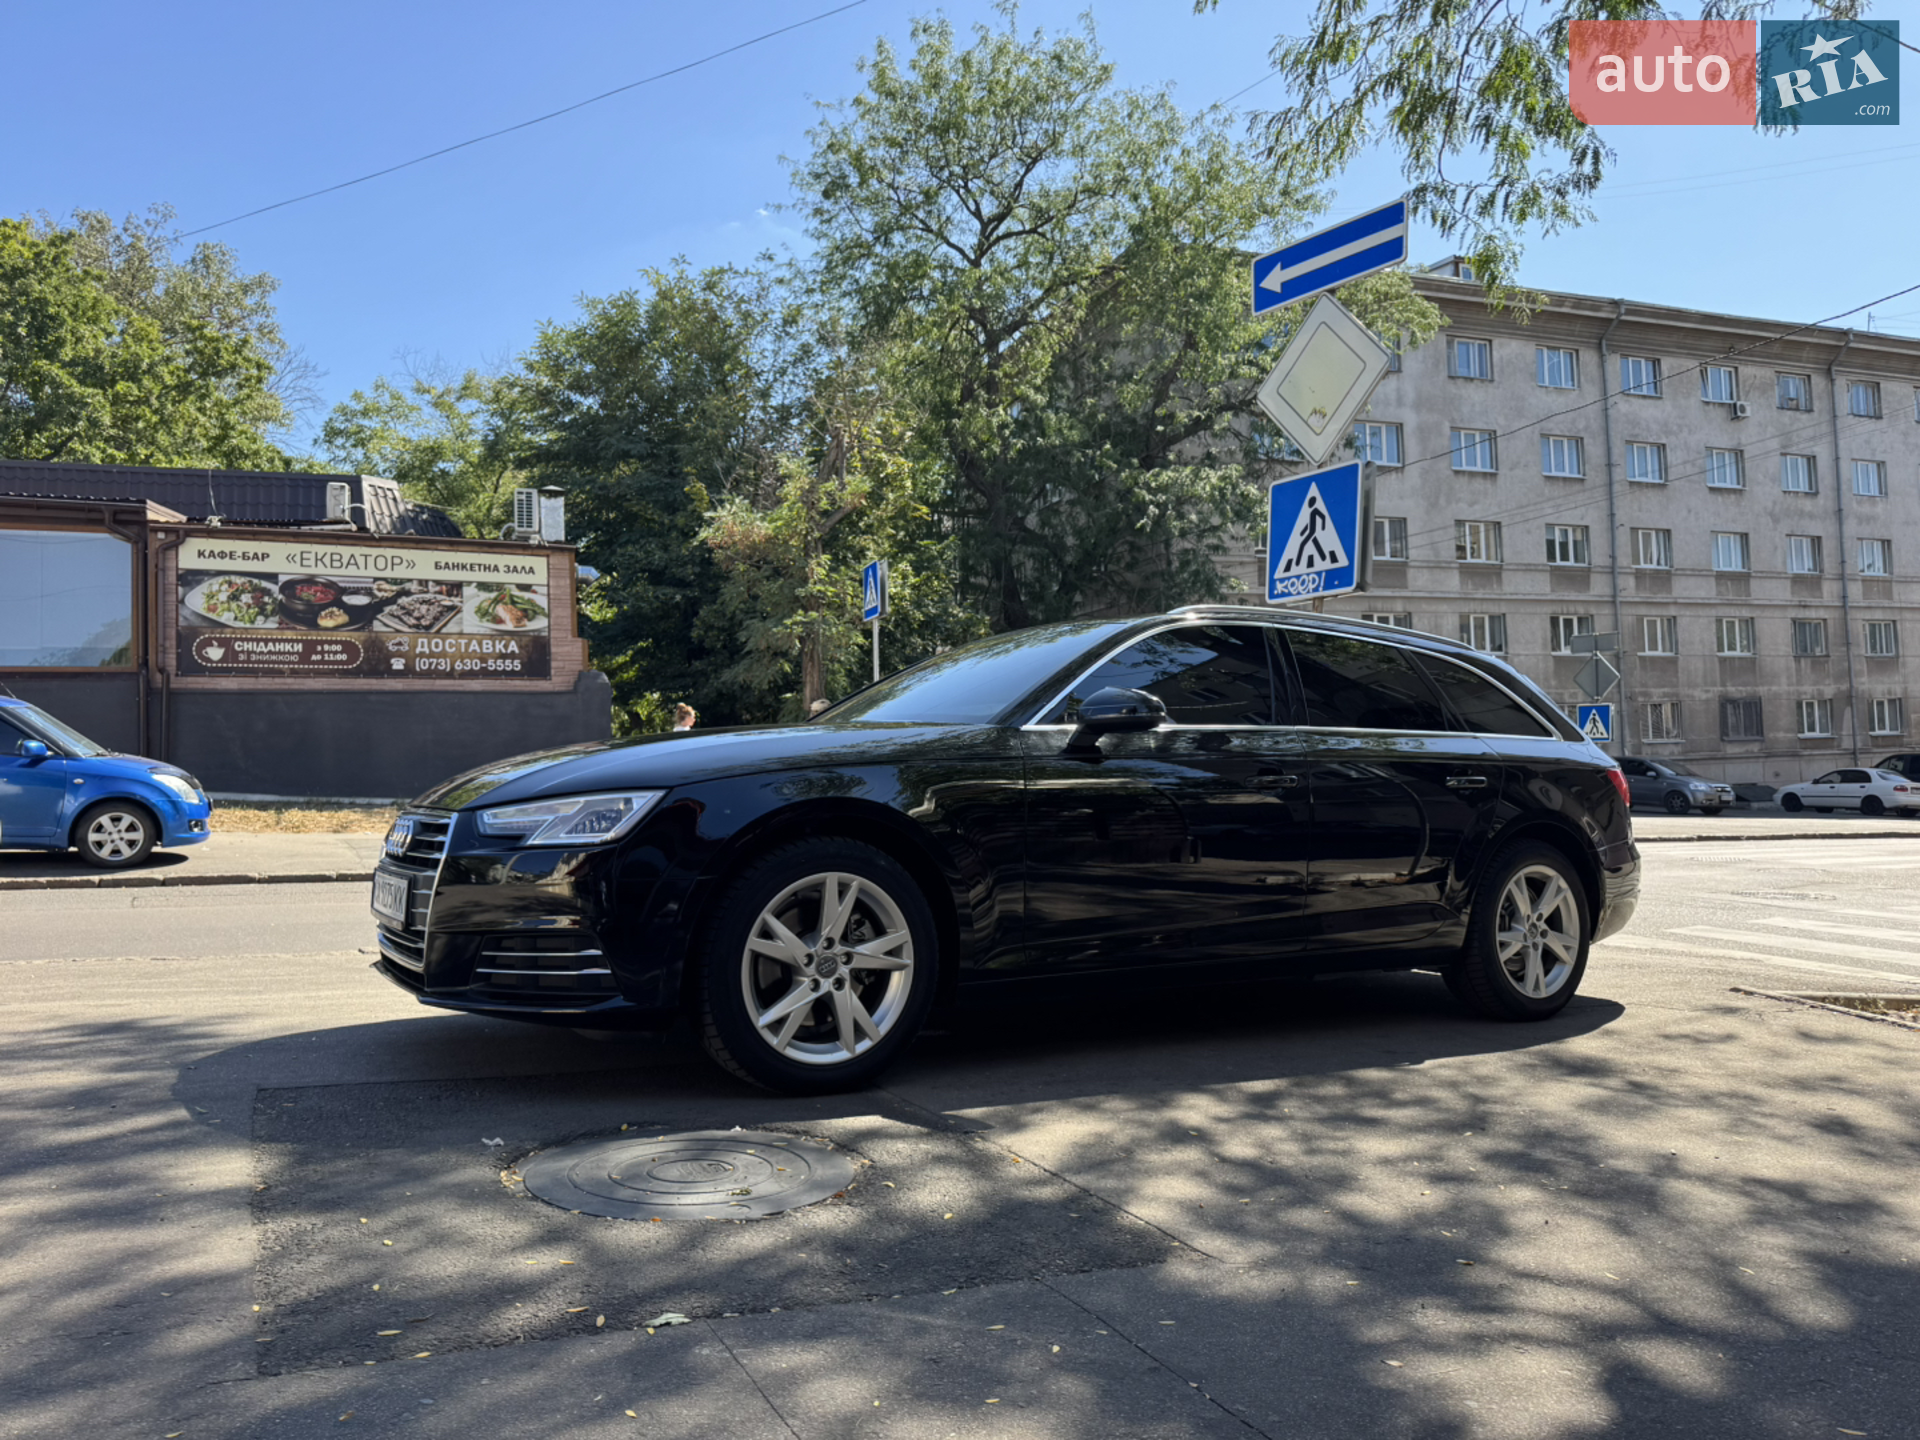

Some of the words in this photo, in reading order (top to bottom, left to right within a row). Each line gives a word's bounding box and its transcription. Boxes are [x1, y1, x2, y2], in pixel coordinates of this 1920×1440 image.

[197, 549, 270, 562] КАФЕ-БАР
[285, 550, 417, 572] «ЕКВАТОР»
[434, 560, 501, 574] БАНКЕТНА
[503, 564, 536, 575] ЗАЛА
[234, 641, 303, 653] СНІДАНКИ
[323, 644, 343, 652] 9:00
[415, 638, 519, 654] ДОСТАВКА
[250, 653, 299, 662] знижкою
[323, 653, 348, 661] 11:00
[415, 657, 451, 672] (073)
[454, 658, 522, 672] 630-5555
